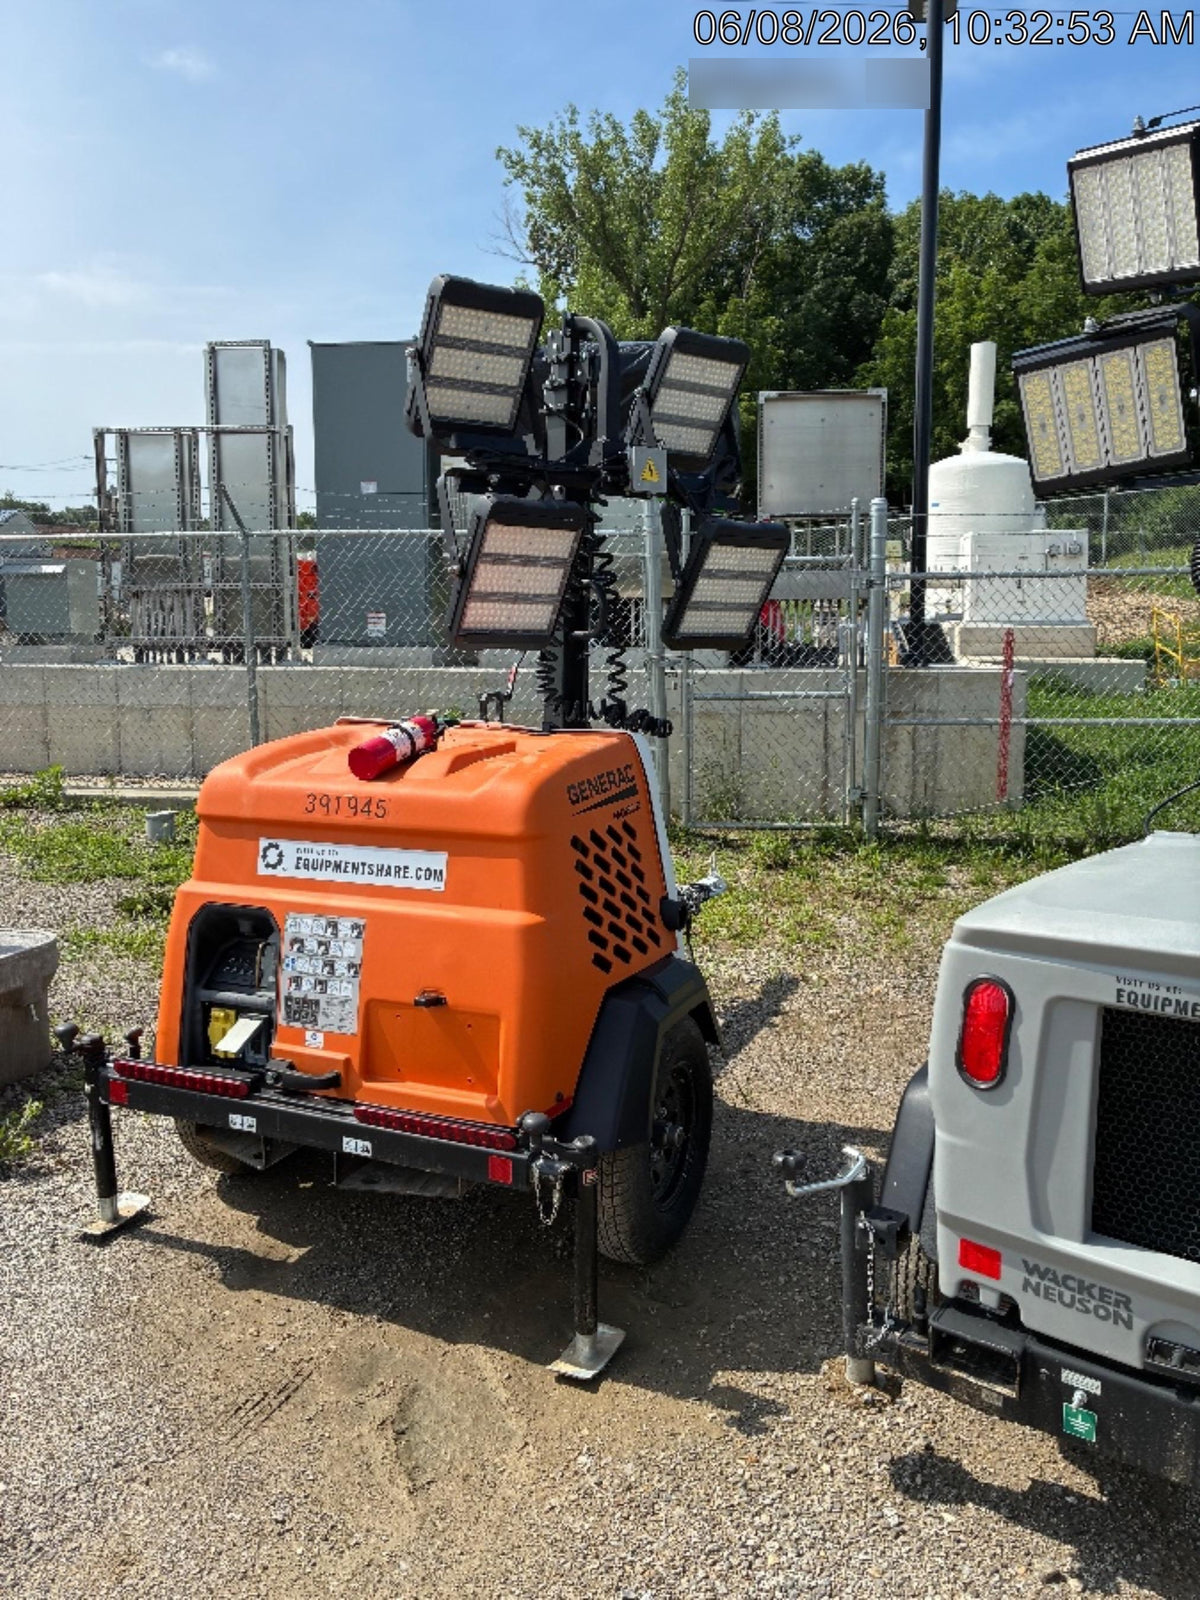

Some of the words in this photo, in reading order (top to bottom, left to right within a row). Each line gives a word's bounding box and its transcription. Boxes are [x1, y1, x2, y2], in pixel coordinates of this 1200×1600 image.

[304, 793, 387, 819] 391945
[566, 763, 636, 806] GENERAC
[294, 856, 444, 882] EQUIPMENTSHARE.COM
[1022, 1259, 1134, 1313] WACKER
[1022, 1277, 1134, 1331] NEUSON
